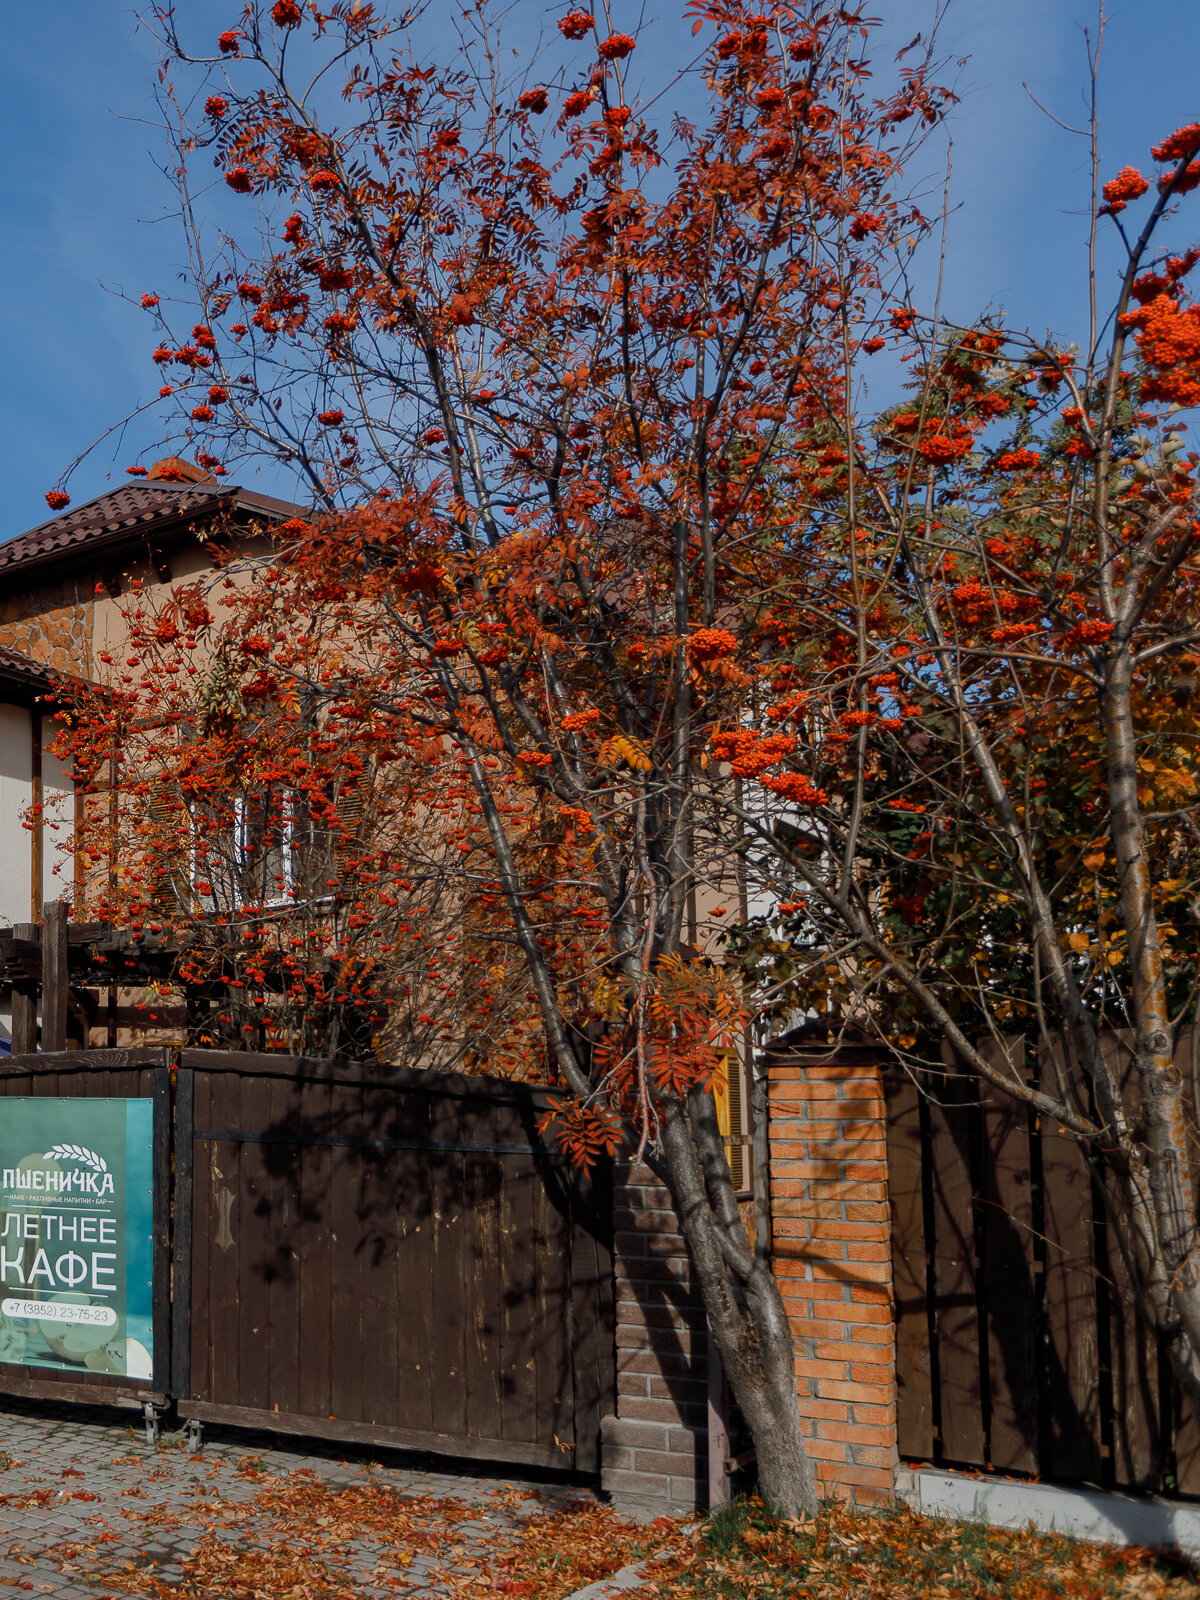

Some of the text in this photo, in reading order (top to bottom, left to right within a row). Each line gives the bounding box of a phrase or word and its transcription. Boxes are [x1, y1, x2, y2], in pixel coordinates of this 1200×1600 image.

[2, 1168, 115, 1197] ПШЕНИЧКА
[28, 1195, 63, 1203] РАЗЛИВНЫЕ
[1, 1212, 117, 1245] ЛЕТНЕЕ
[1, 1246, 117, 1291] КАФЕ
[9, 1303, 108, 1322] +7 (3852) 23-75-23
